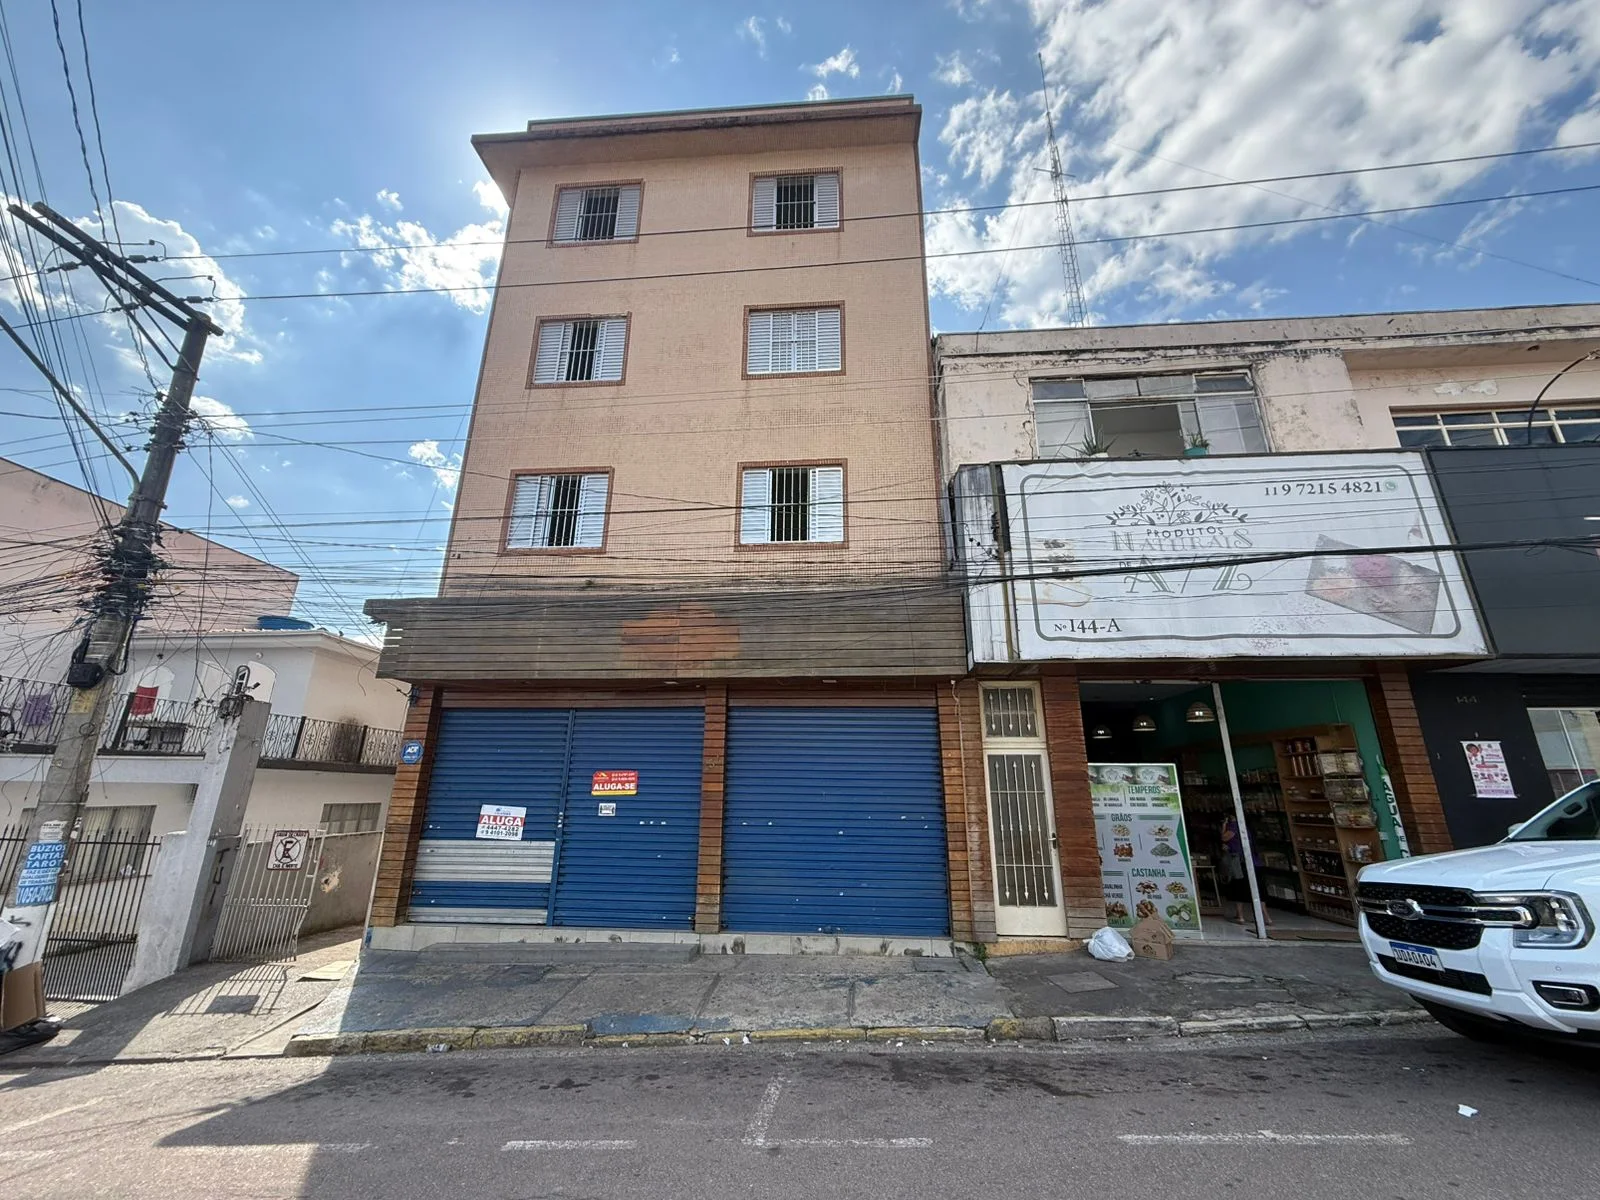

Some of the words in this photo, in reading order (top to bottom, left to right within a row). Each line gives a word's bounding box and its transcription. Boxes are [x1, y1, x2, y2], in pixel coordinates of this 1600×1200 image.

[1264, 486, 1278, 496] 11
[1281, 483, 1292, 496] 9
[1296, 482, 1338, 496] 7215
[1341, 480, 1383, 494] 4821
[1146, 525, 1224, 539] PRODUTOS
[1110, 528, 1253, 552] NATURAIS
[1069, 618, 1123, 634] 144-A
[593, 782, 637, 791] ALUGA-SE
[1127, 785, 1161, 795] TEMPEROS
[481, 815, 522, 827] ALUGA
[1111, 813, 1133, 822] GRÃOS
[26, 859, 63, 868] TAROT
[1131, 868, 1167, 878] CASTANHA
